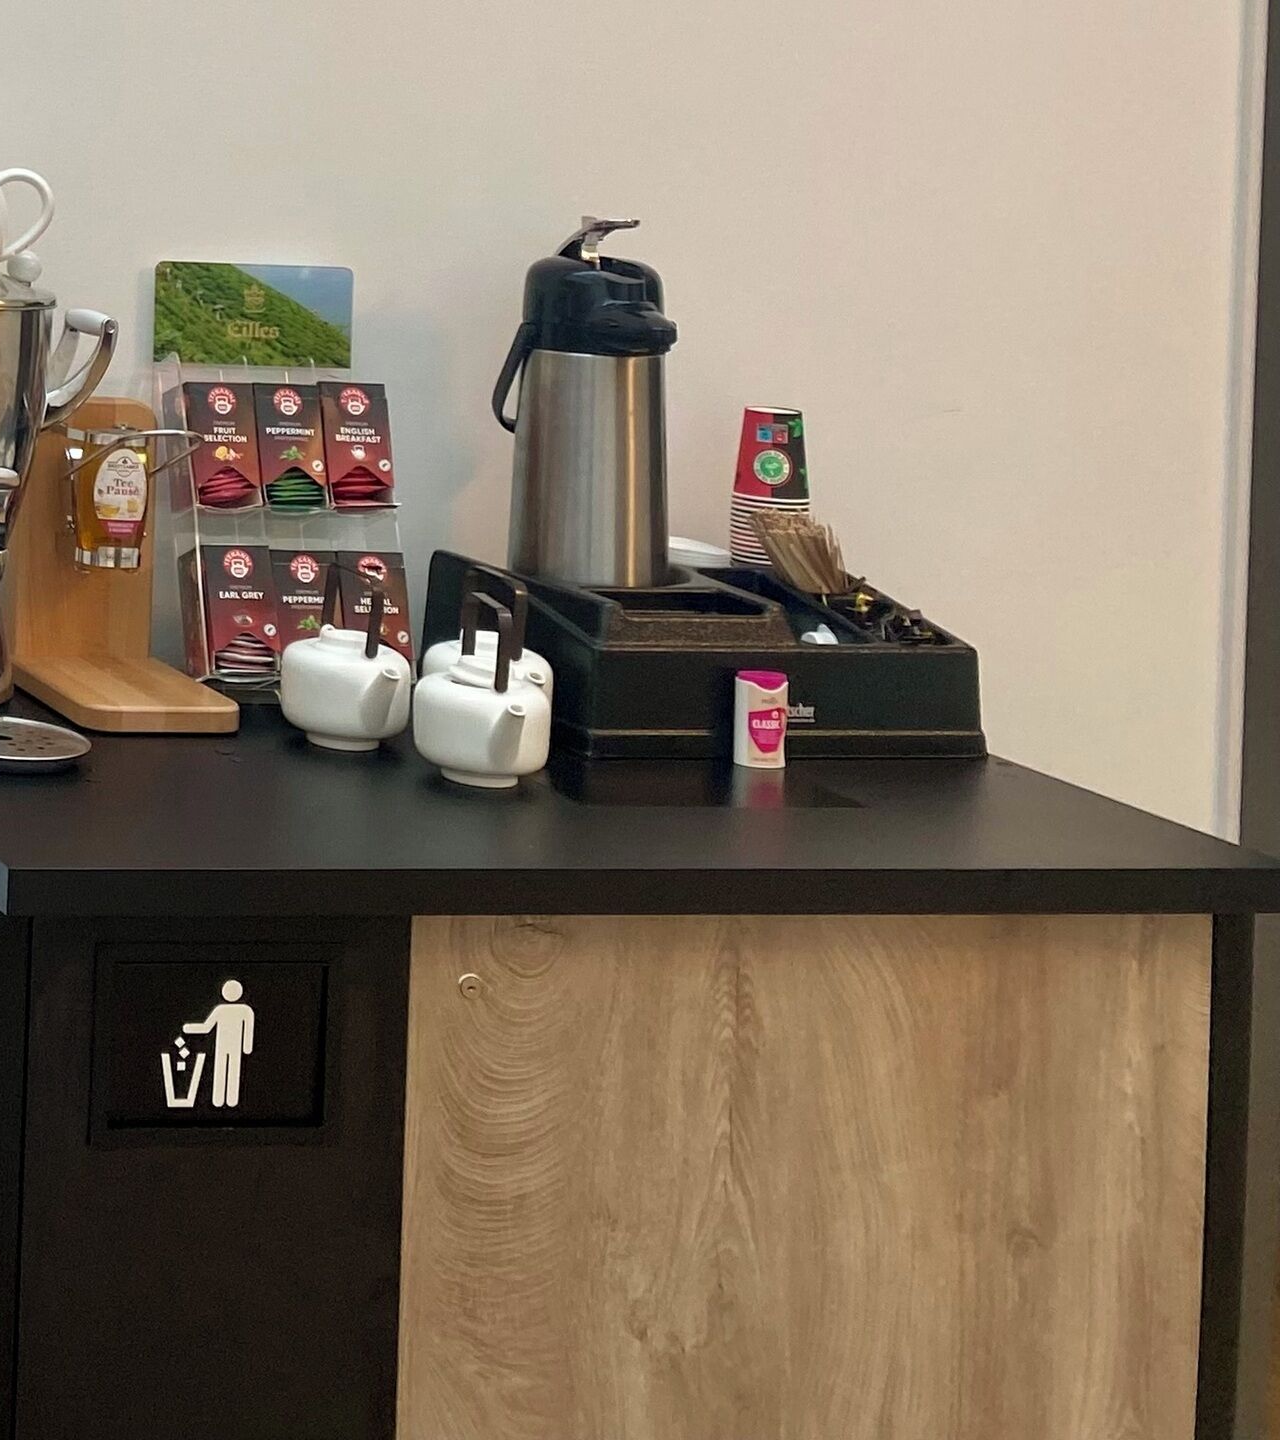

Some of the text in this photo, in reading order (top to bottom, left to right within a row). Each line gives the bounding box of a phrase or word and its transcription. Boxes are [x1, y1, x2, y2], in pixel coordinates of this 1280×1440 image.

[227, 320, 281, 339] Eilles
[213, 426, 236, 435] FRUIT
[265, 427, 315, 437] PEPPERMINT
[340, 426, 376, 436] ENGLISH
[203, 434, 248, 443] SELECTION
[335, 433, 381, 444] BREAKFAST
[113, 478, 134, 488] Tee
[219, 590, 265, 601] EARL GREY
[282, 595, 325, 605] PEPPERMI
[360, 597, 392, 607] HEAL
